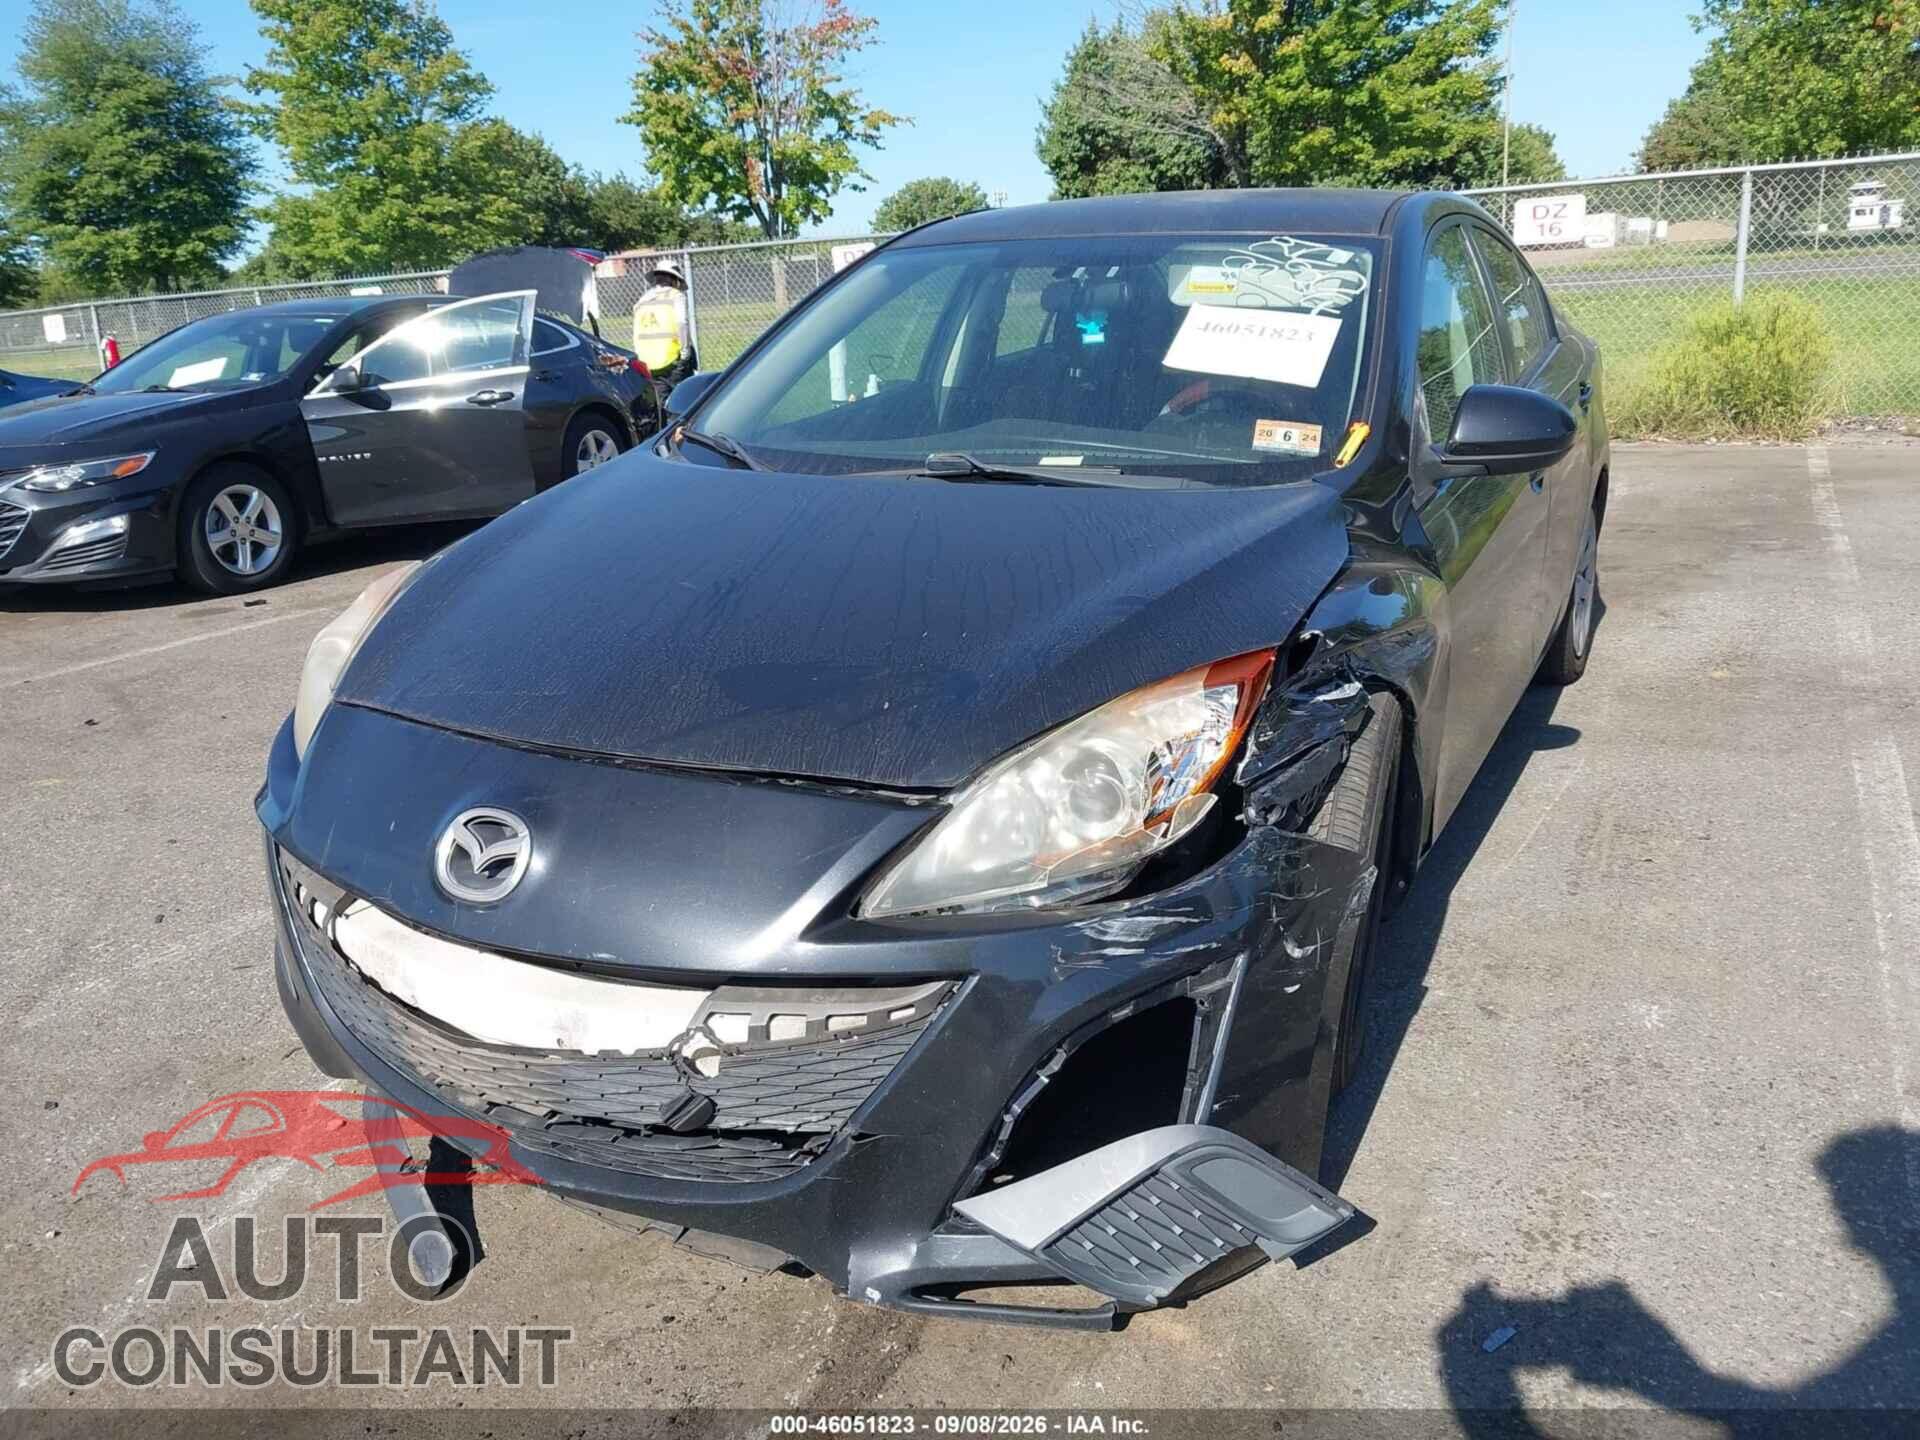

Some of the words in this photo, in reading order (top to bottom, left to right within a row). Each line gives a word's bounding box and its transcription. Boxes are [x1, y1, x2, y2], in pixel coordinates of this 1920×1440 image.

[1532, 203, 1568, 220] DZ
[1537, 222, 1563, 237] 16
[1283, 430, 1292, 442] 6
[1302, 433, 1317, 442] 24
